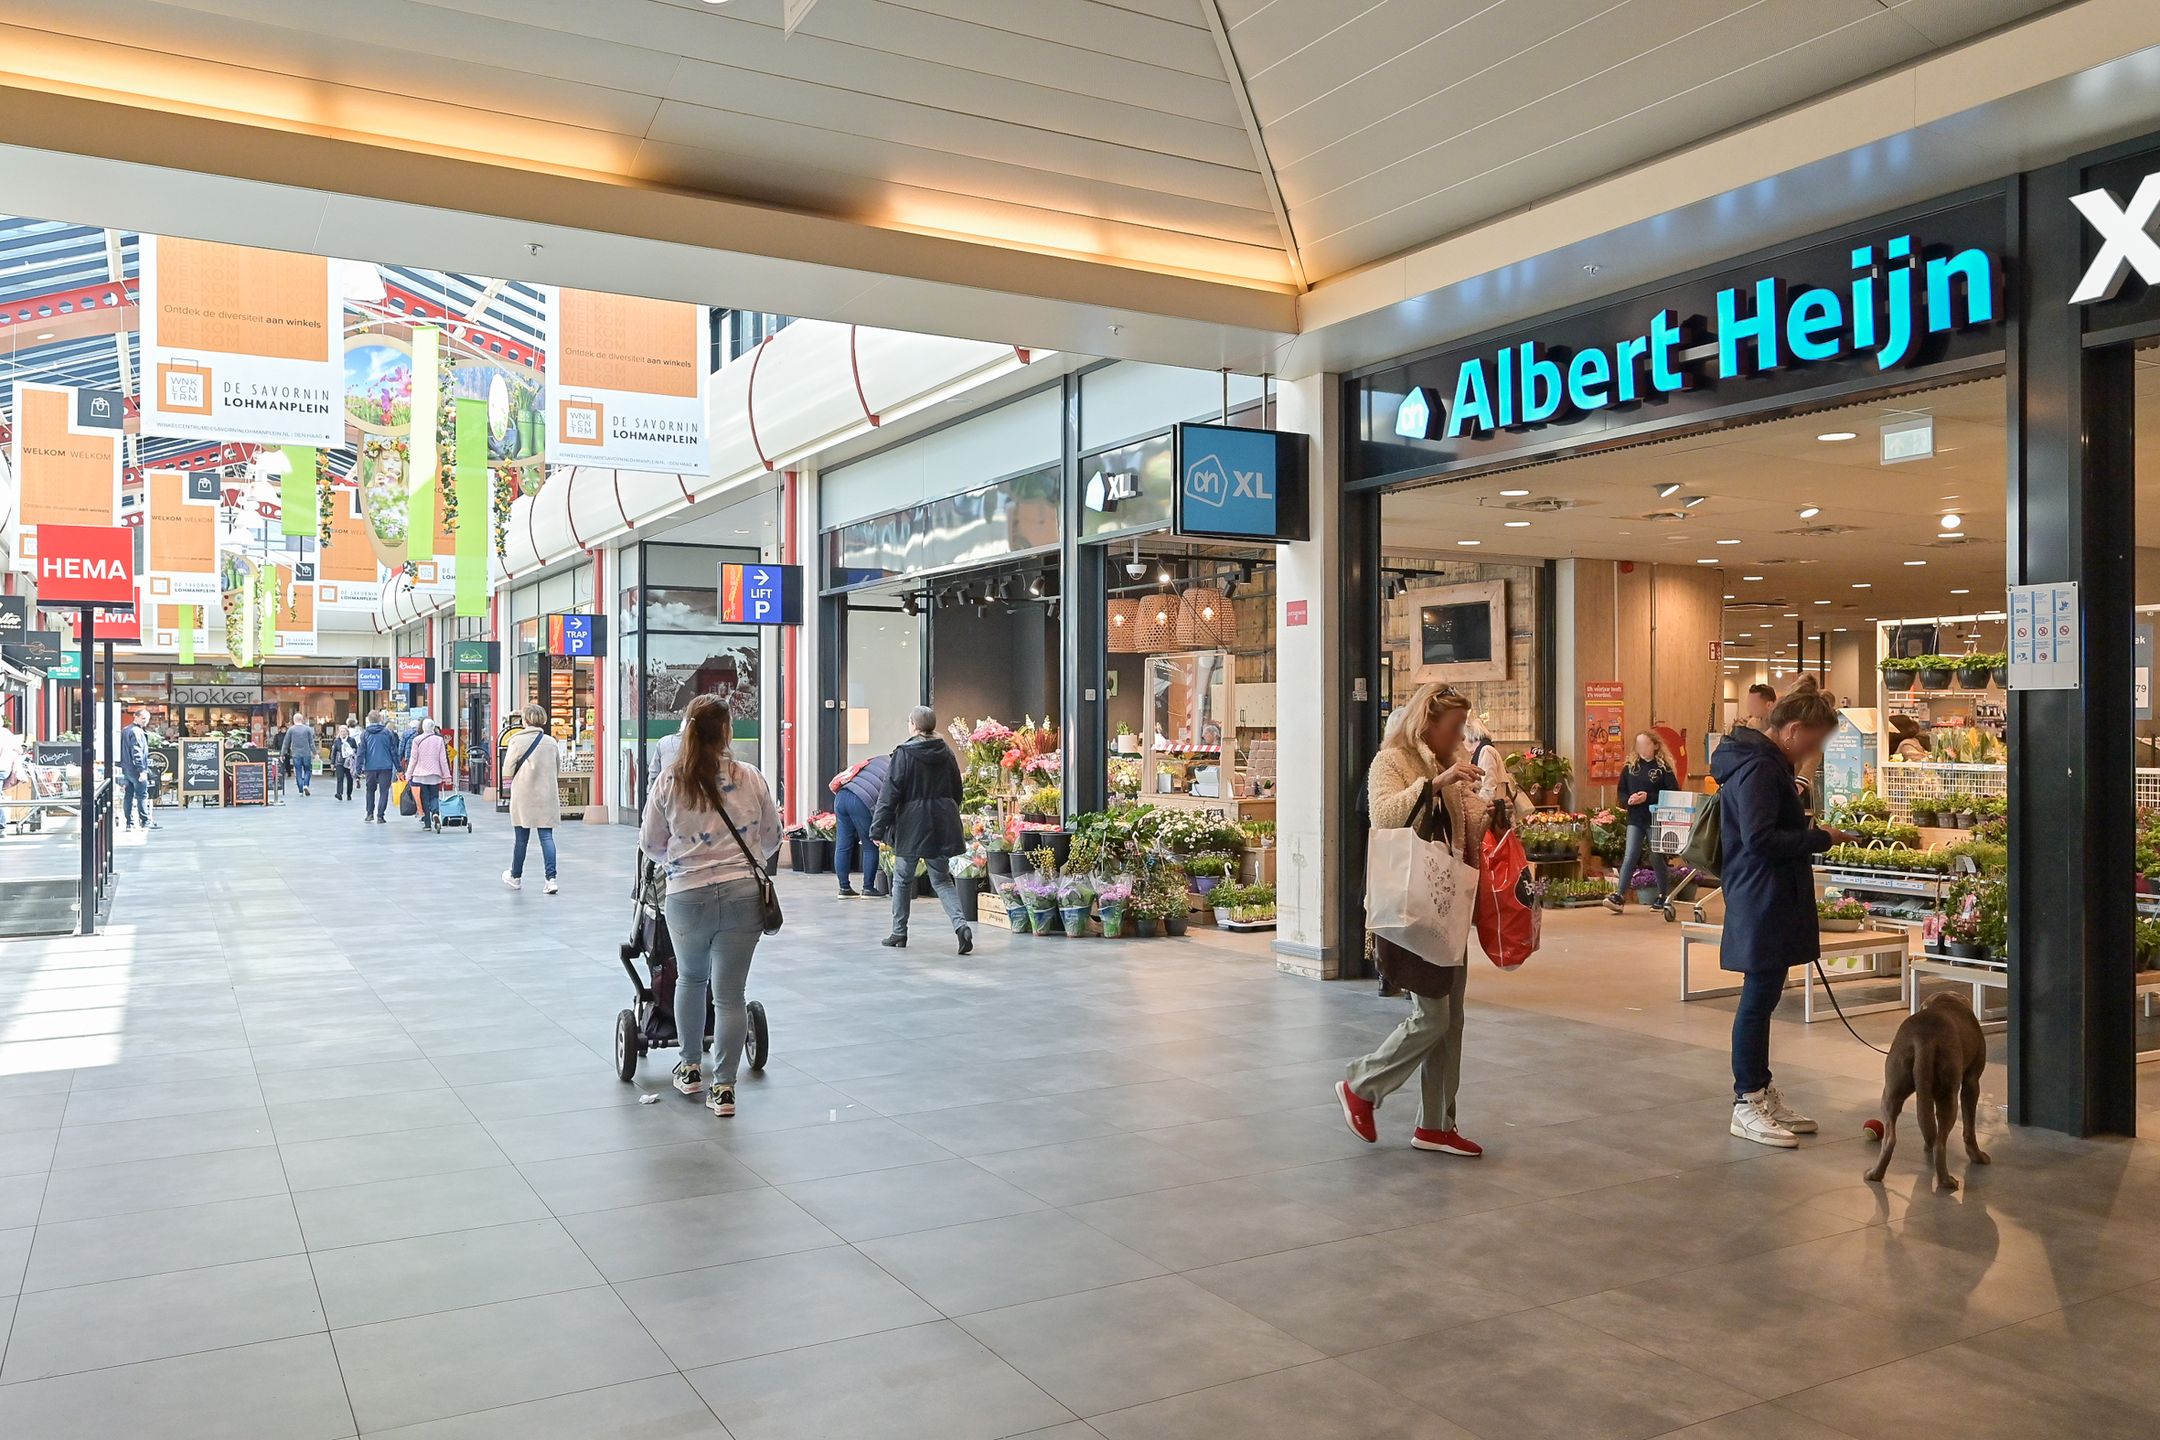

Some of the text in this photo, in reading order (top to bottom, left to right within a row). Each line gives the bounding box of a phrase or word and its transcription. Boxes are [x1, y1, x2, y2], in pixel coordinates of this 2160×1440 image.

[164, 304, 322, 329] Ontdek de diversiteit aan winkels
[1448, 308, 1683, 438] Albert
[1717, 235, 1993, 379] Heijn
[565, 347, 692, 369] Ontdek de diversiteit aan winkels
[171, 376, 198, 386] WNK
[172, 385, 197, 394] LCN
[224, 381, 330, 400] DE SAVORNIN
[172, 393, 198, 402] TRM
[224, 397, 330, 414] LOHMANPLEIN
[570, 412, 592, 421] WNK
[571, 420, 591, 428] LCN
[613, 416, 698, 432] DE SAVORNIN
[570, 426, 592, 435] TRM
[613, 430, 698, 445] LOHMANPLEIN
[23, 447, 111, 460] WELKOM WELKOM
[1107, 472, 1137, 500] XL
[1232, 470, 1273, 499] XL
[43, 557, 128, 580] HEMA
[750, 588, 773, 599] LIFT
[755, 600, 770, 619] P
[566, 630, 588, 639] TRAP
[572, 639, 584, 653] P
[174, 688, 254, 704] blokker
[187, 762, 209, 771] Verse
